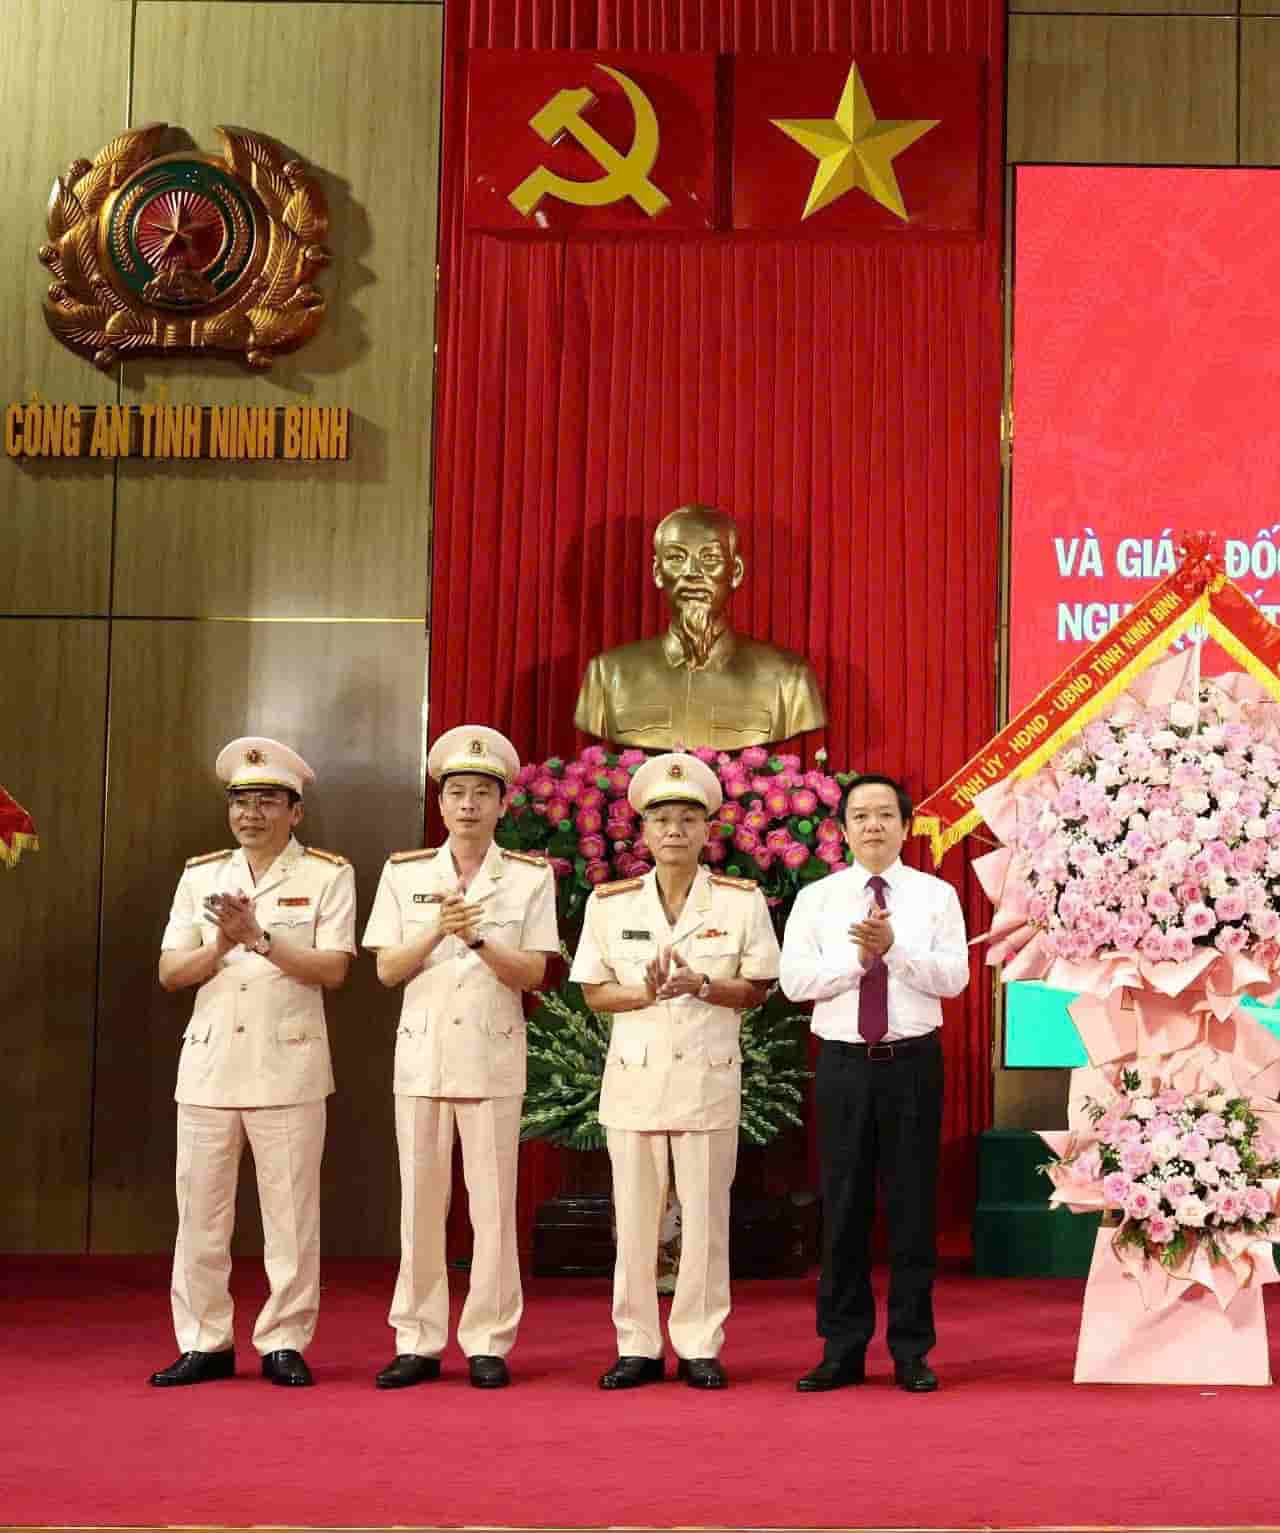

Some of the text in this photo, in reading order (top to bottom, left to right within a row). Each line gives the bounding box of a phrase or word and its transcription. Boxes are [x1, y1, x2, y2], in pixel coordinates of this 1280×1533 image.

[6, 391, 81, 457] CÔNG
[89, 405, 130, 457] AN
[209, 407, 275, 459] NINH
[284, 396, 350, 460] BÌNH
[1054, 527, 1104, 577] VÀ
[1115, 527, 1190, 577] GIÁ
[1053, 672, 1093, 712] UBND
[1120, 615, 1157, 649] NINH
